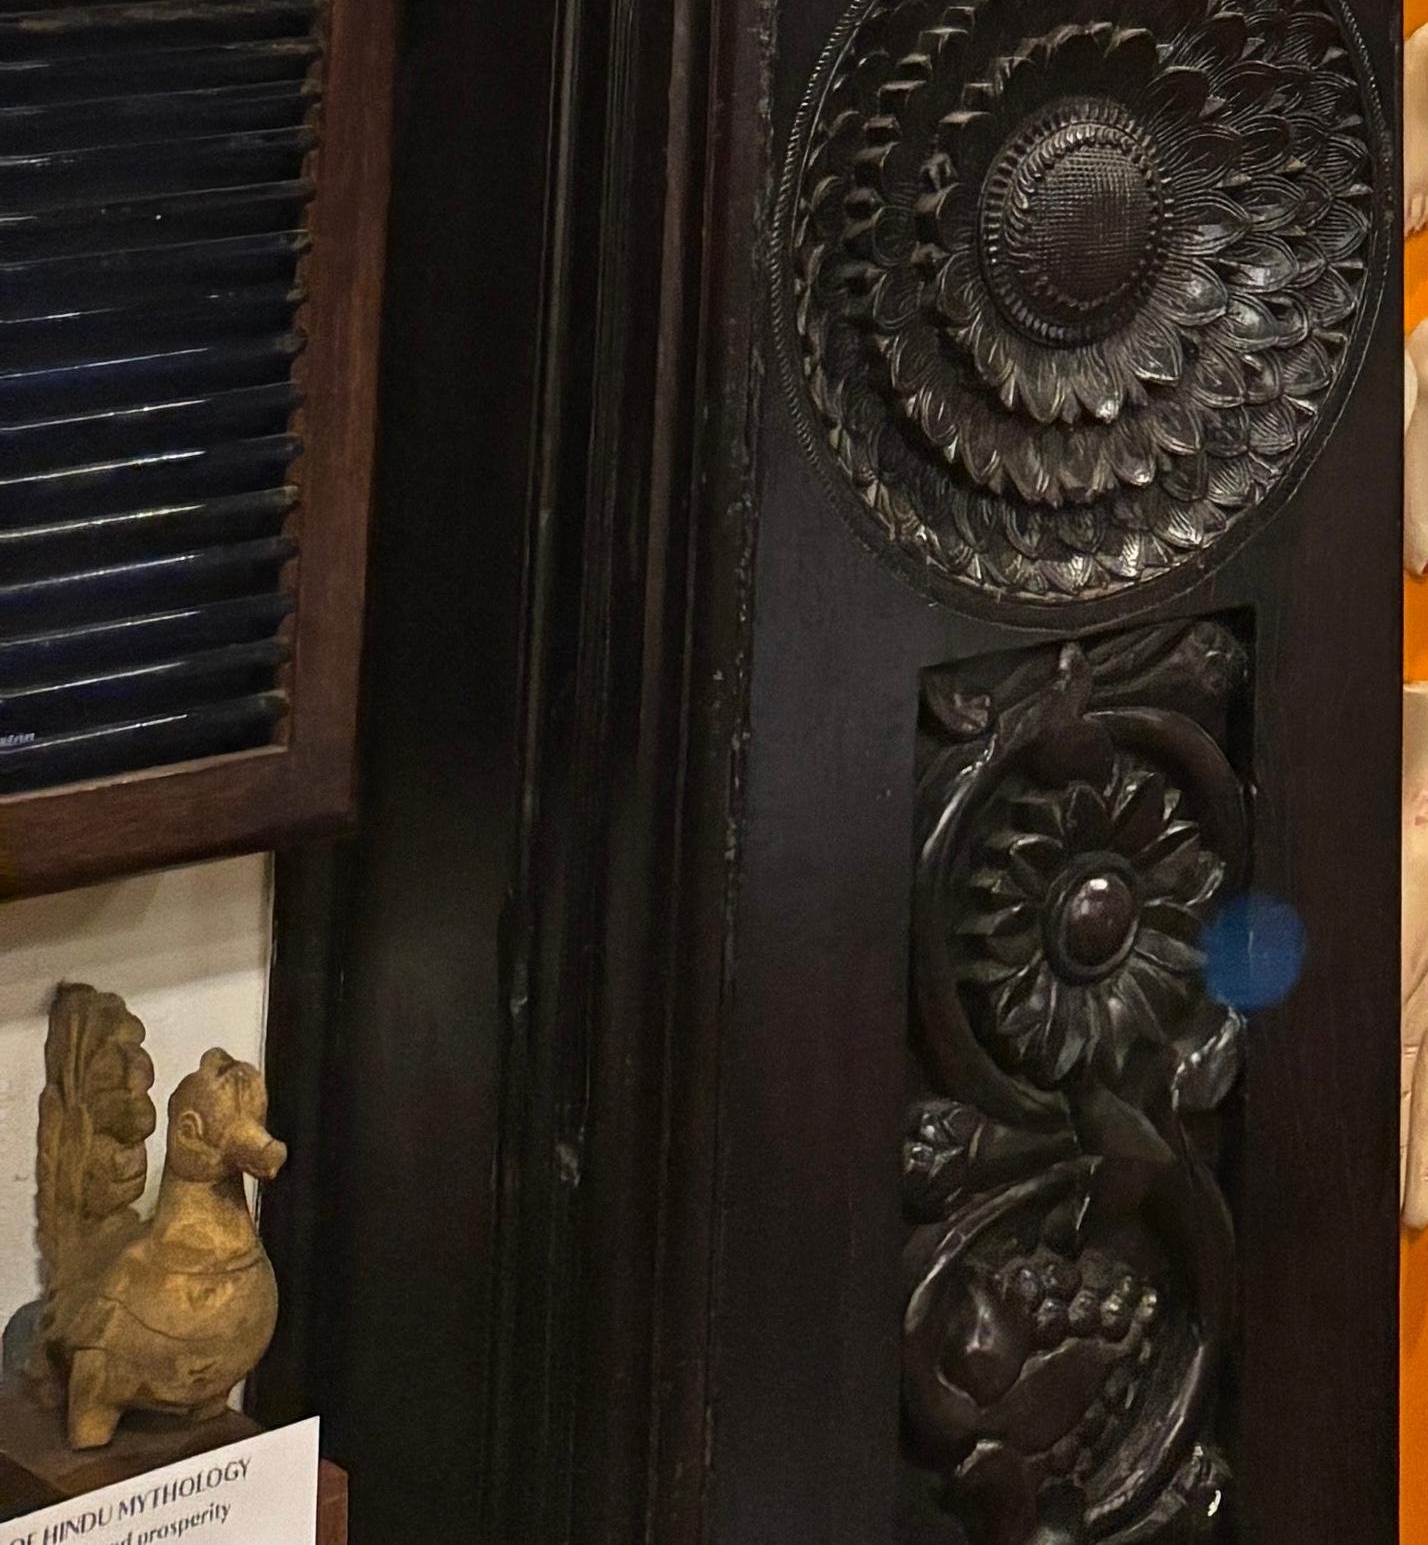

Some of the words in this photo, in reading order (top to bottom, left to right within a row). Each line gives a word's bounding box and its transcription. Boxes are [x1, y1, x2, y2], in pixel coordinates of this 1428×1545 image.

[42, 1506, 113, 1545] HINDU
[118, 1458, 250, 1520] MYTHOLOGY
[138, 1501, 232, 1545] prosperity
